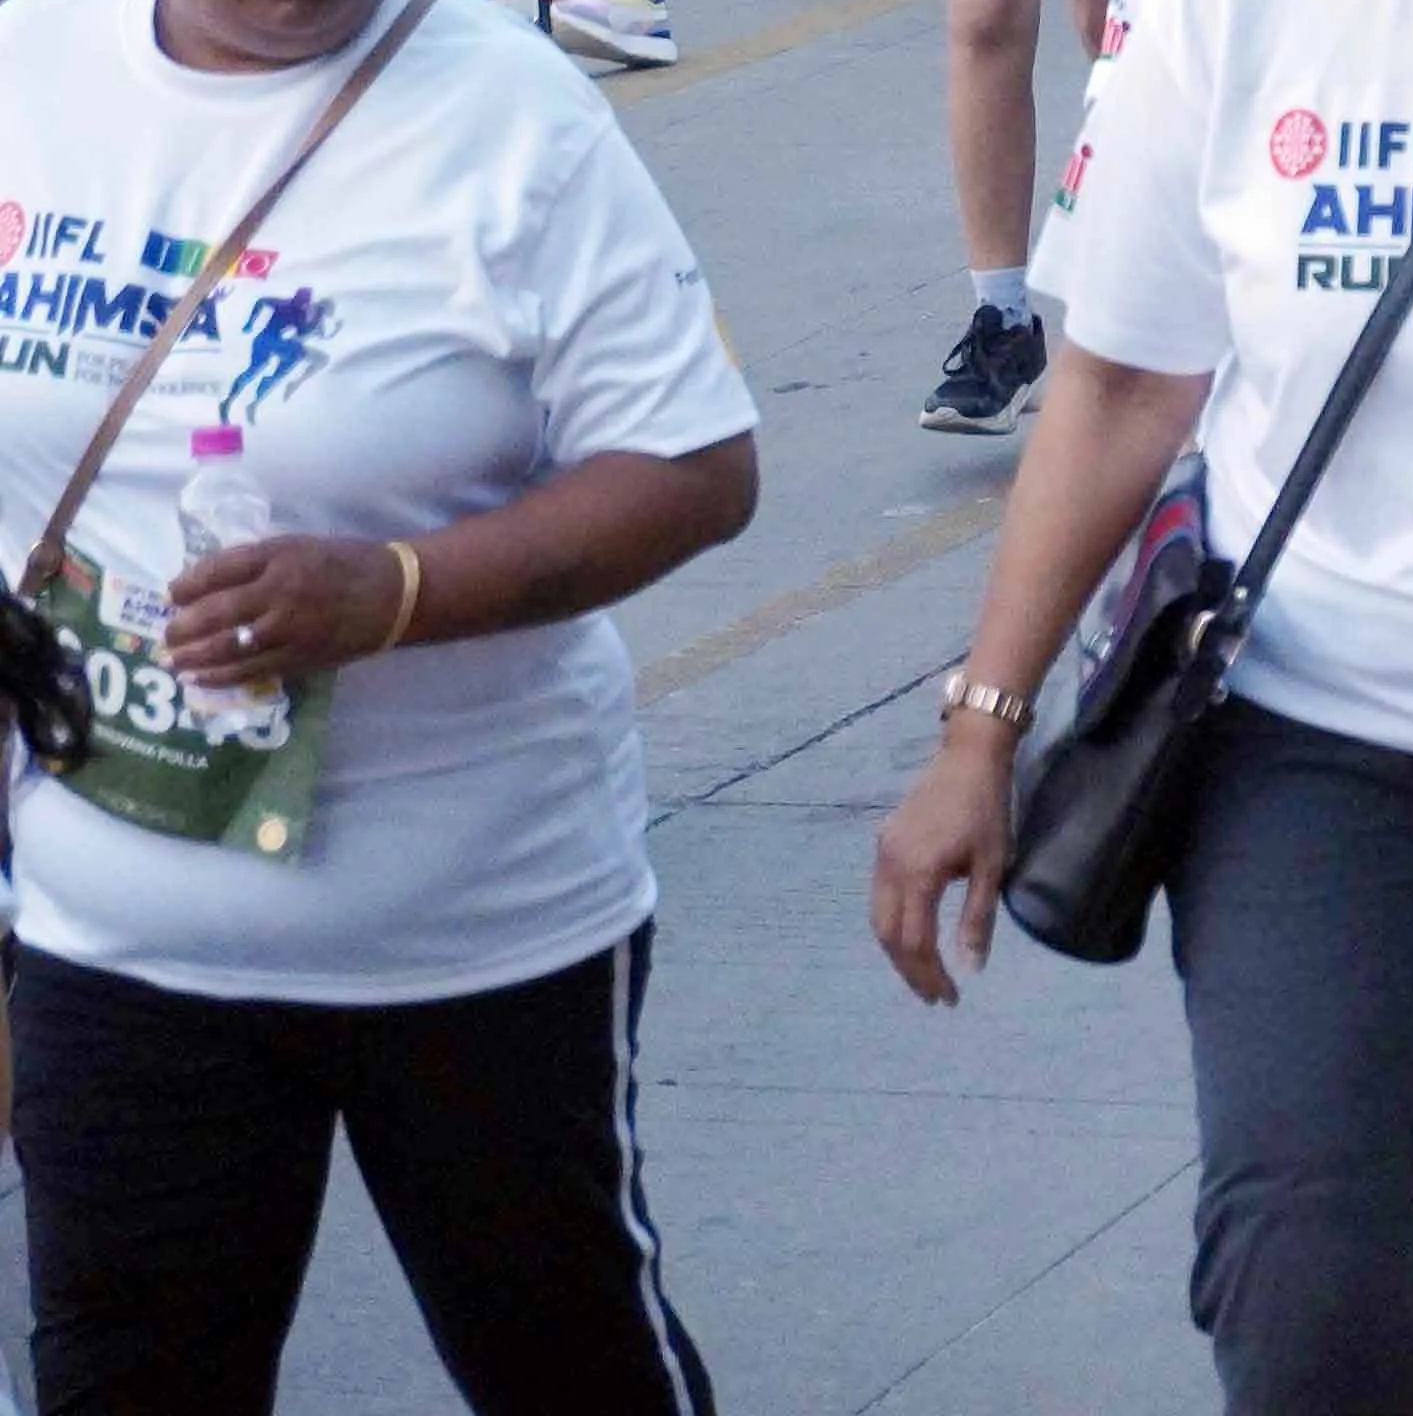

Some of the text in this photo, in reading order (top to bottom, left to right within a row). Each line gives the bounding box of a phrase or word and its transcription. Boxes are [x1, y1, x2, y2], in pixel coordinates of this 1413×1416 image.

[26, 212, 275, 276] IIFL JIO
[0, 336, 70, 377] UN
